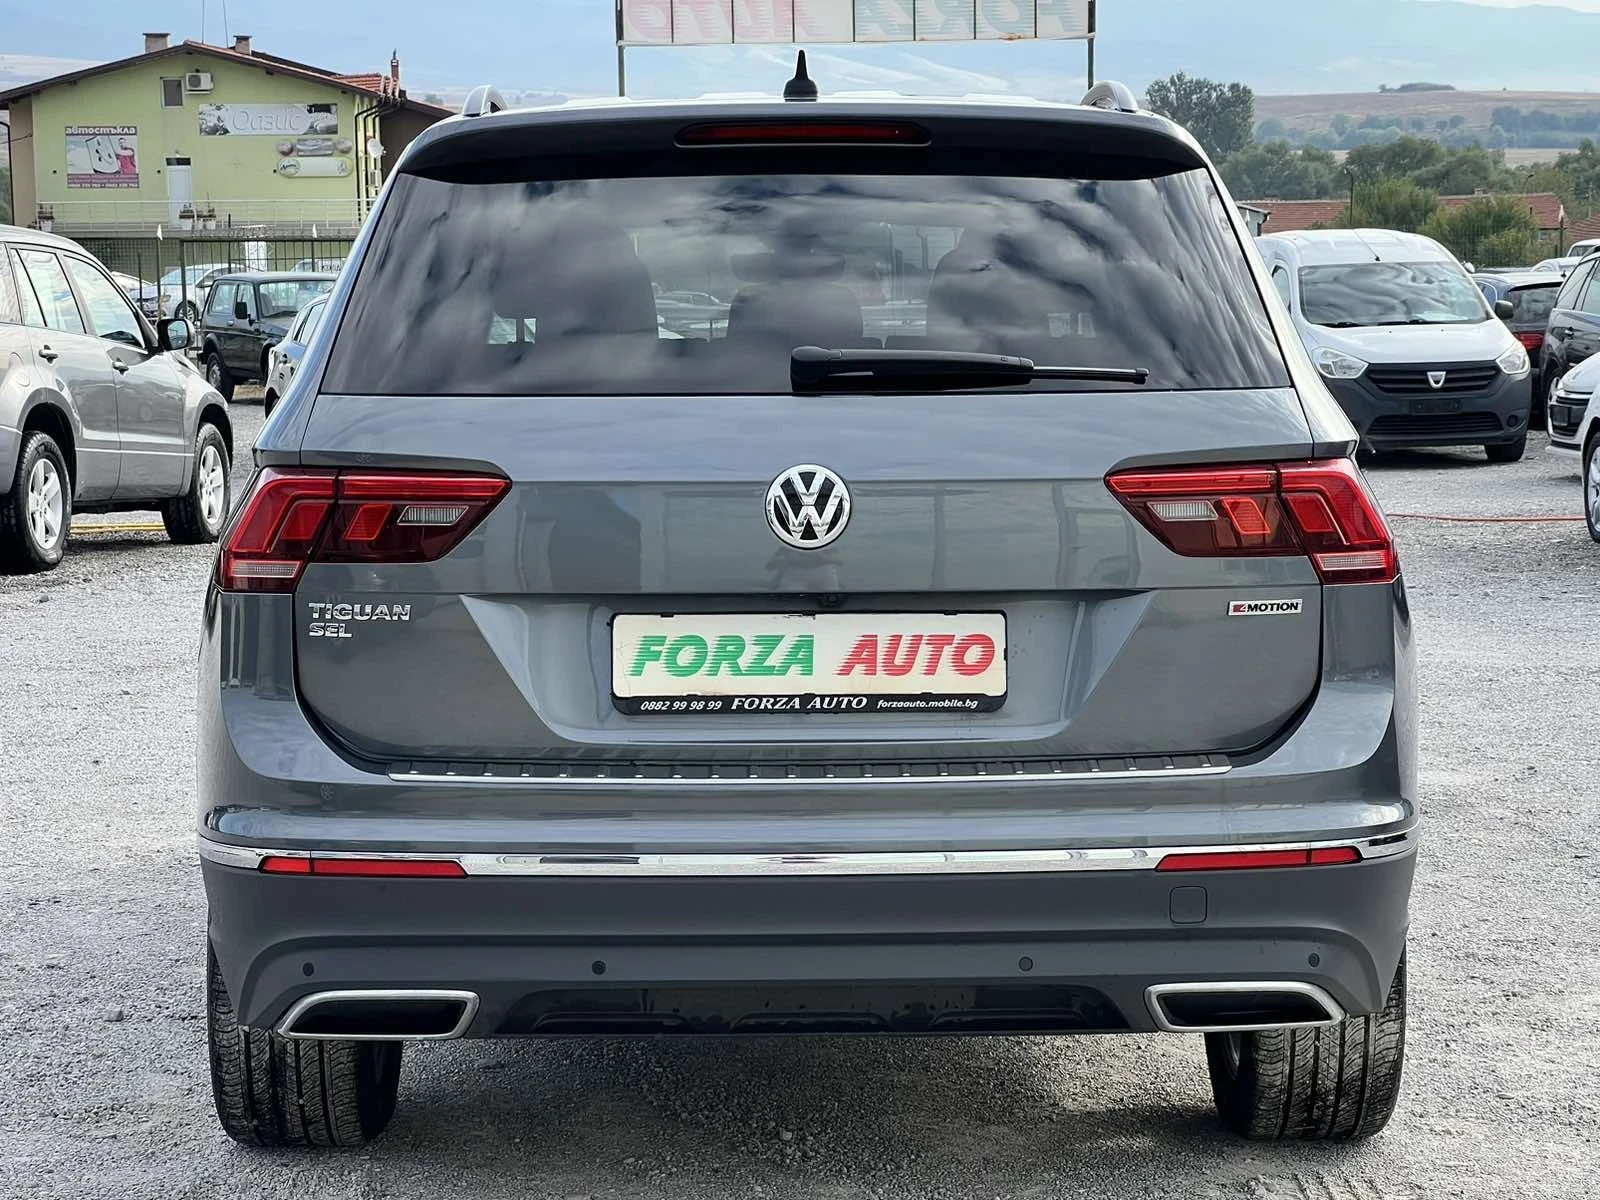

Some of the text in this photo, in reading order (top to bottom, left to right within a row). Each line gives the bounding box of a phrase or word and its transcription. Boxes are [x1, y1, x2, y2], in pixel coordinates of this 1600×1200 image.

[308, 602, 411, 620] TIGUAN
[308, 622, 352, 638] SEL
[627, 634, 995, 677] FORZA AUTO
[640, 696, 978, 711] 0882 99 98 99 FORZA AUTO forzaauto.mobile.bg
